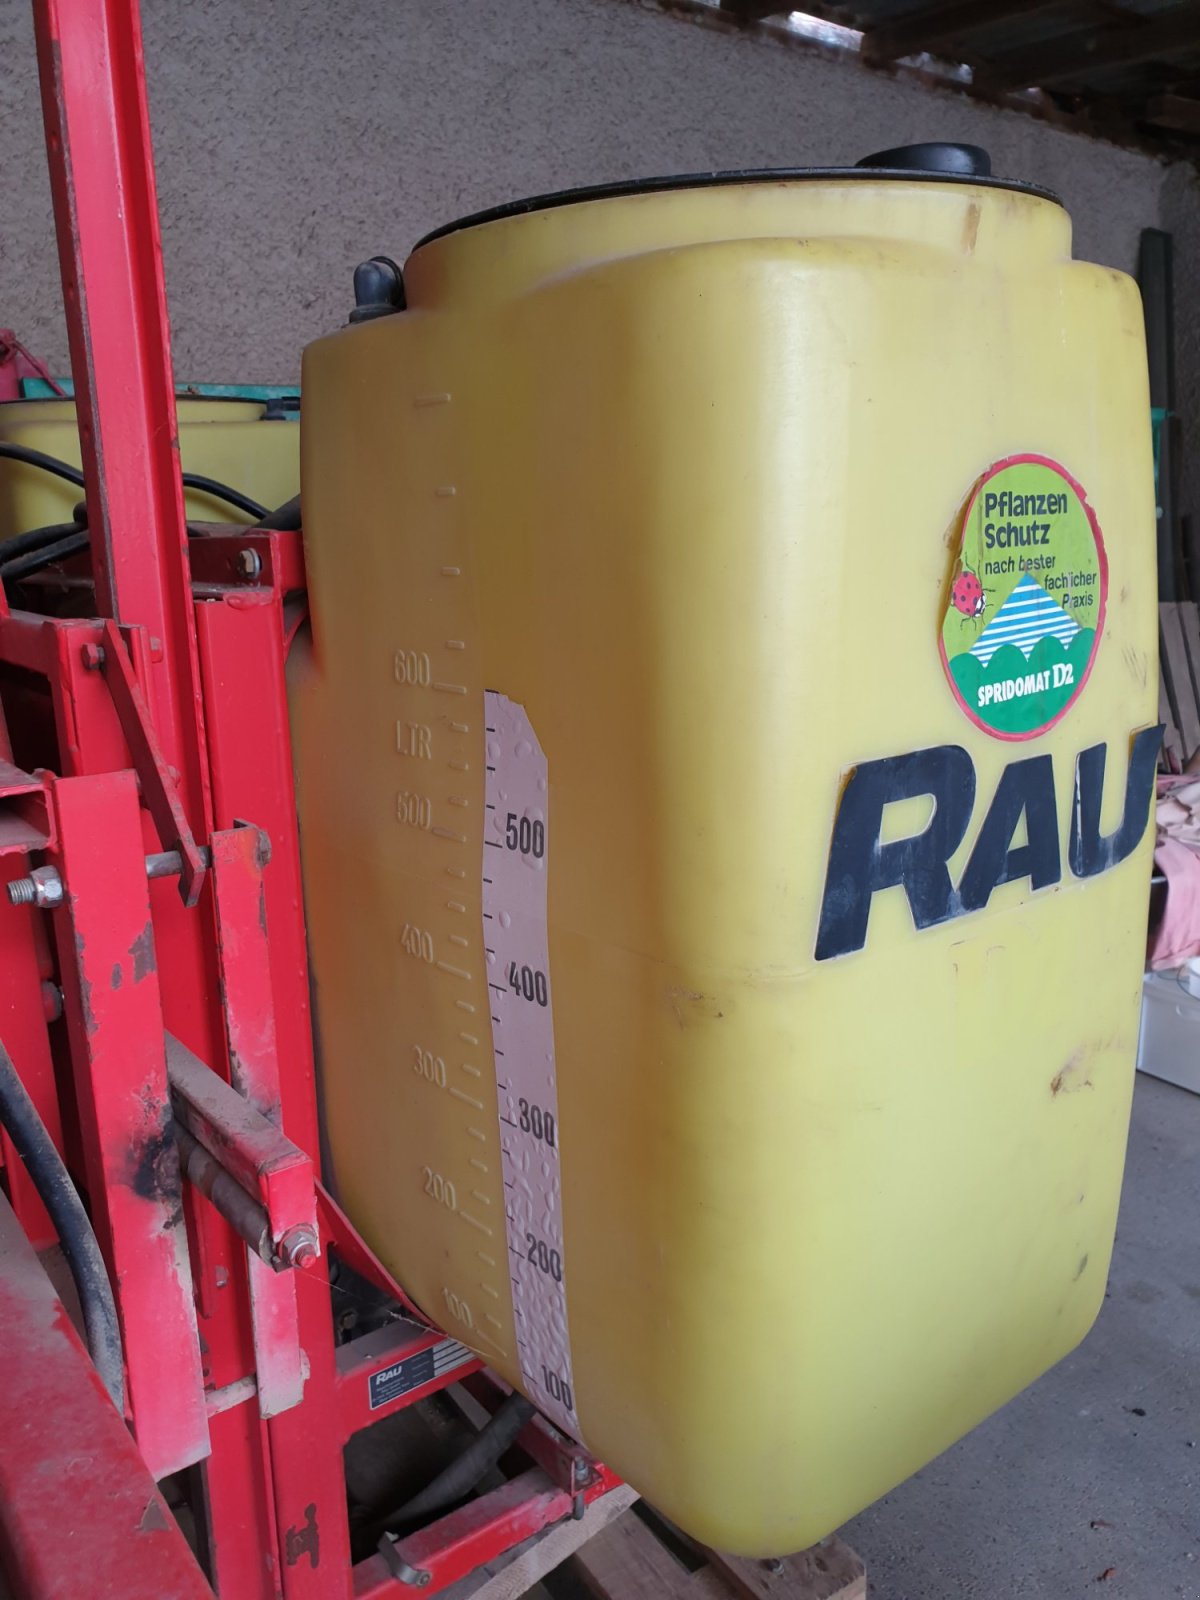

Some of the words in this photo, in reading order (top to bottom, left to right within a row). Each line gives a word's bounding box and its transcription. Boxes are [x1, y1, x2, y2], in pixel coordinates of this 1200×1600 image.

[984, 490, 1067, 518] Pflanzen
[984, 521, 1050, 549] Schutz
[985, 556, 1015, 575] nach
[1018, 554, 1056, 571] bester
[1044, 571, 1097, 590] fachicher
[977, 671, 1050, 707] SPRIDOMAT
[1052, 663, 1074, 688] D2
[396, 720, 432, 760] LTR
[506, 812, 545, 859] 500
[814, 724, 1166, 961] RAU
[401, 923, 434, 963] 400
[509, 962, 548, 1007] 400
[412, 1045, 447, 1088] 300
[518, 1097, 555, 1148] 300
[422, 1166, 458, 1211] 200
[526, 1233, 562, 1283] 200
[376, 1365, 402, 1385] RAU
[540, 1363, 574, 1412] 100
